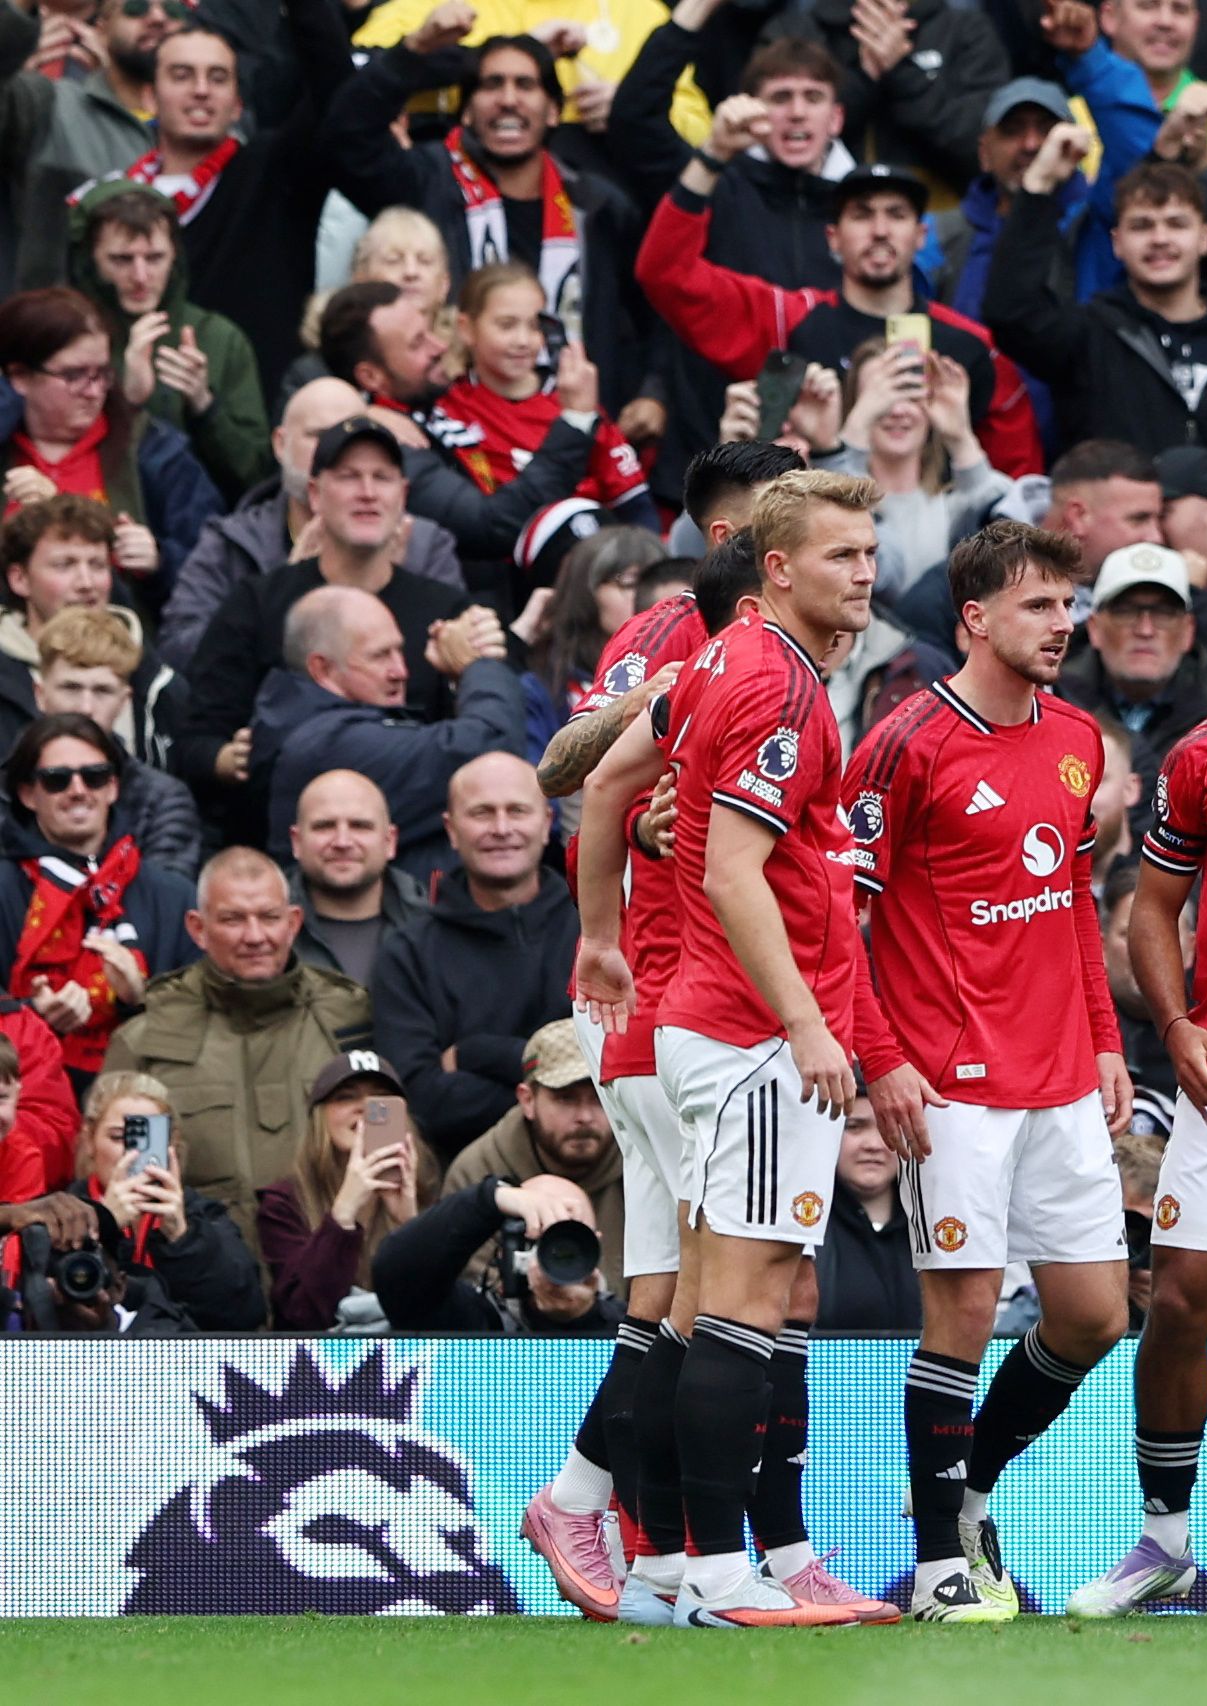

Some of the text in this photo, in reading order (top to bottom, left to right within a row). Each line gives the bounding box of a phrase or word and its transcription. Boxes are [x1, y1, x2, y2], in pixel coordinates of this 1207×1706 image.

[736, 779, 753, 791] for
[740, 769, 782, 798] No room
